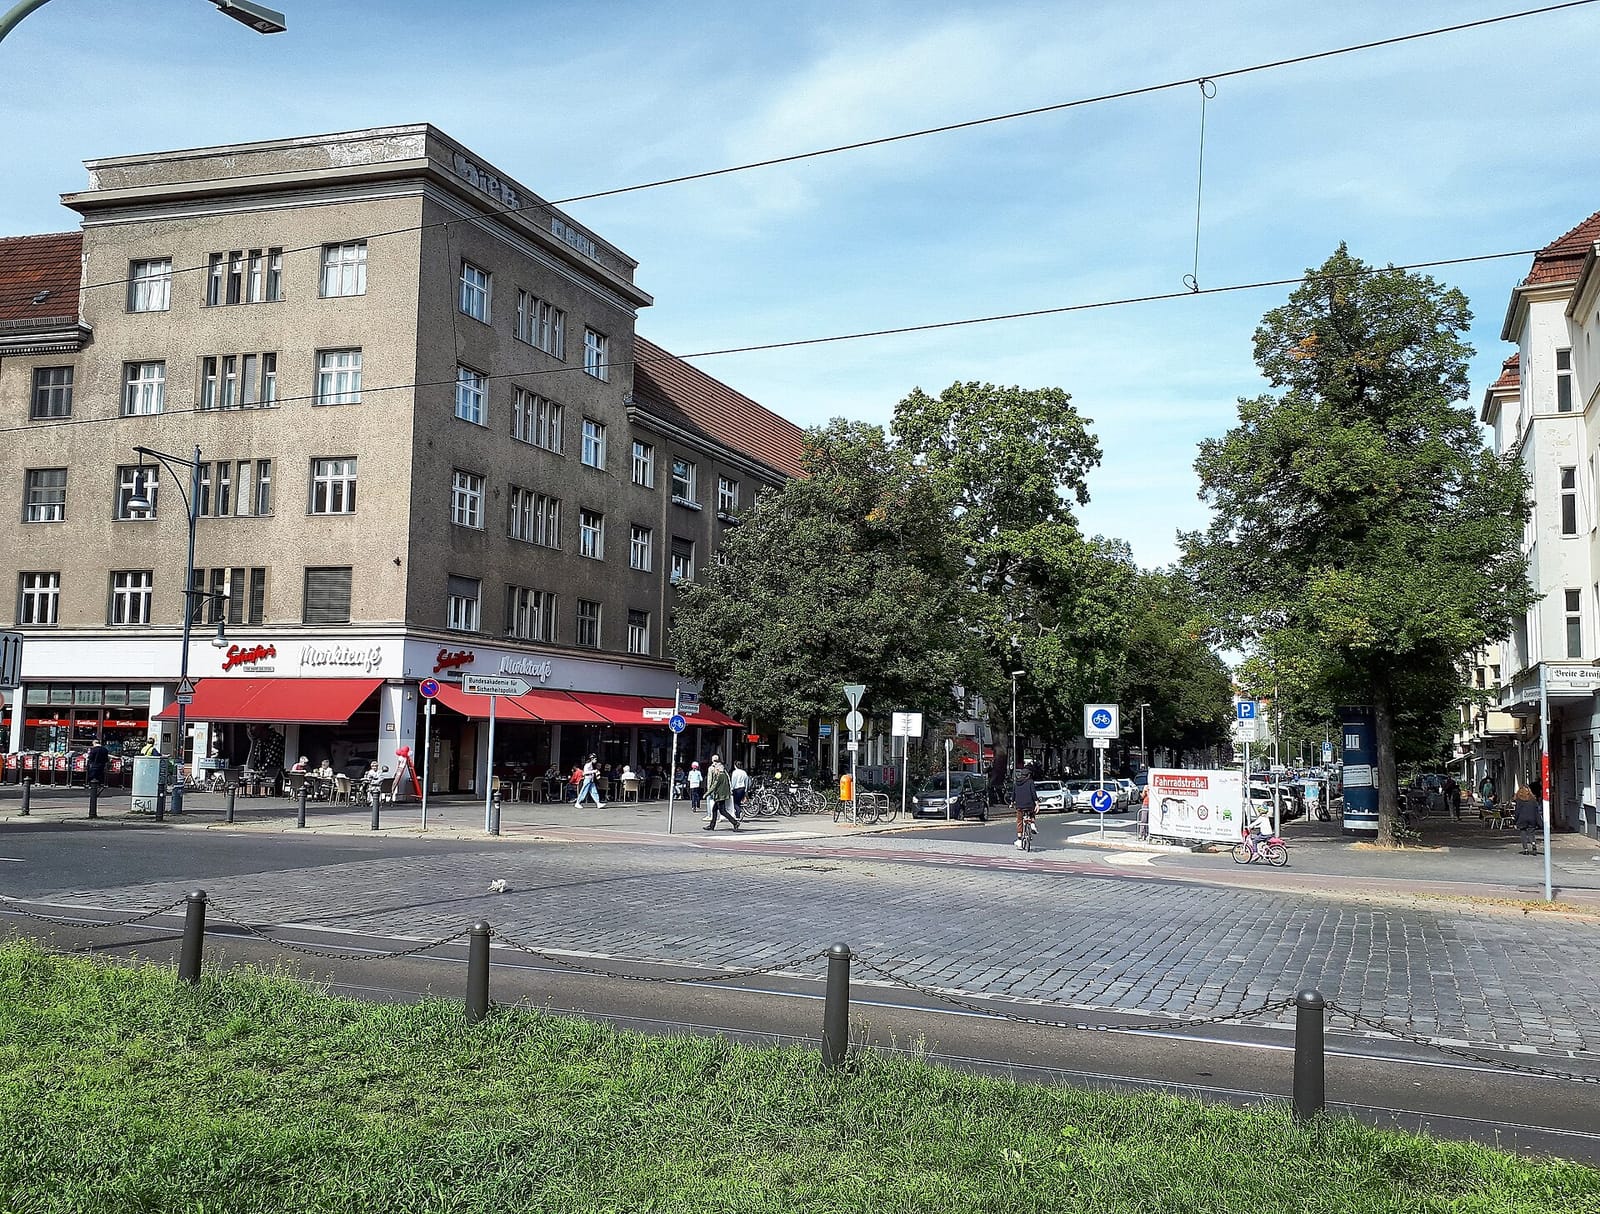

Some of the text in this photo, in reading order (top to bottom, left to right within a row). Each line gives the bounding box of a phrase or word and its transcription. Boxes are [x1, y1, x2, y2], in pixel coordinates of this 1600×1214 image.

[301, 645, 382, 673] Marktcafé
[500, 656, 552, 683] Marktcafé
[1554, 669, 1578, 677] Breite
[469, 677, 509, 686] Bundesakademie
[477, 685, 517, 694] Sicherheitspolitik
[1241, 703, 1251, 717] P
[1154, 776, 1207, 789] Fahrradstraße!
